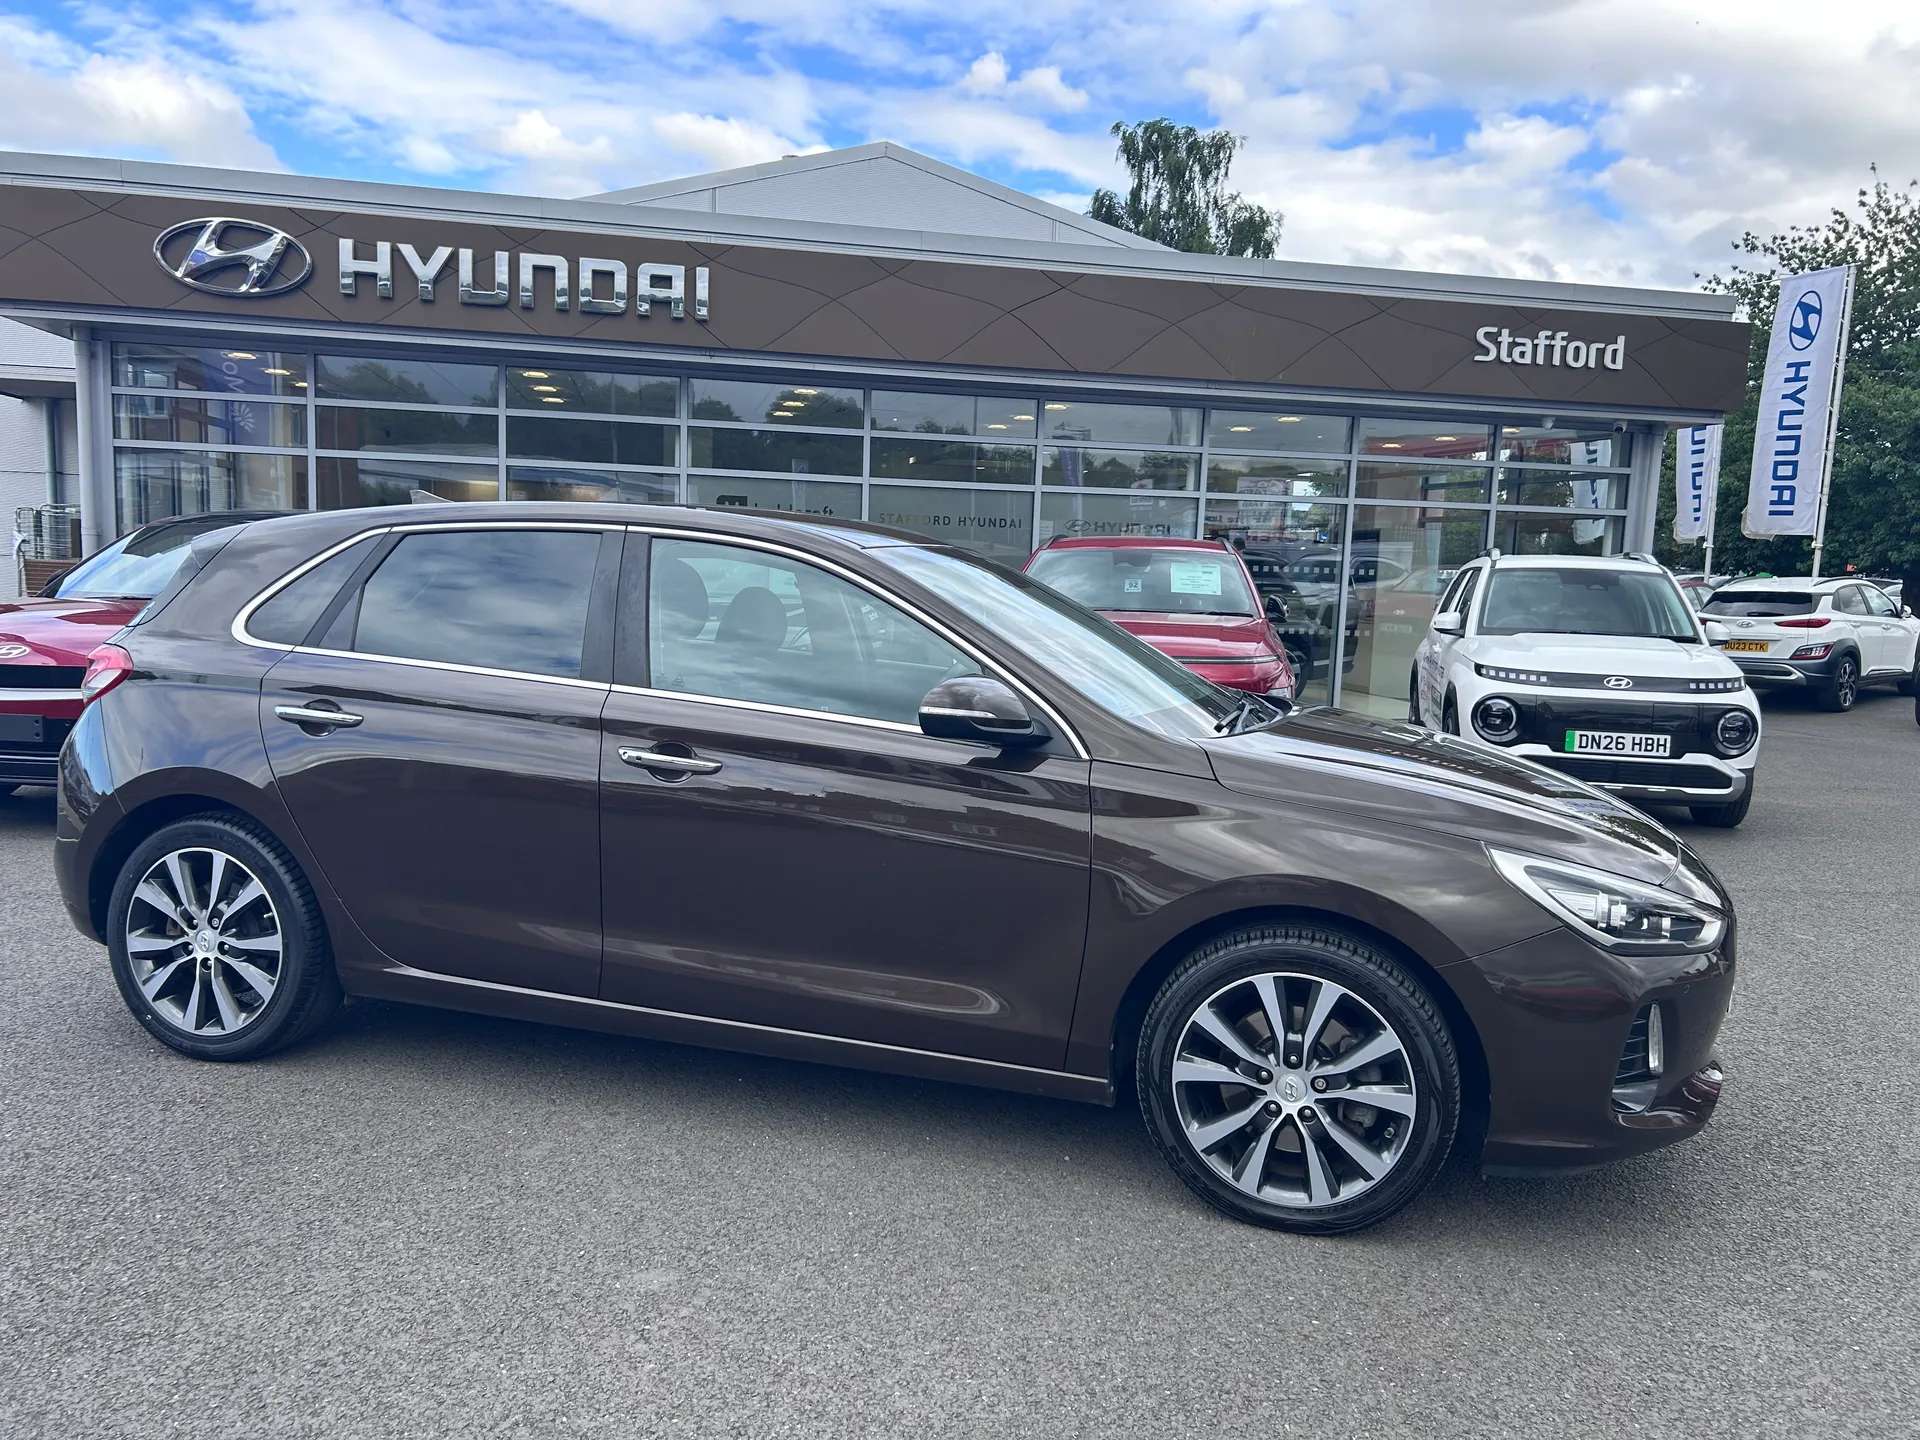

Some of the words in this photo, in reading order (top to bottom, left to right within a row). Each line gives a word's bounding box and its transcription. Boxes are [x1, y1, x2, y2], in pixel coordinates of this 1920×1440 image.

[338, 237, 710, 322] HYUNDAI
[1473, 326, 1626, 370] Stafford
[1767, 360, 1812, 516] HYUNDAI
[957, 514, 1023, 530] HYUNDAI
[1748, 641, 1766, 652] CTK
[1577, 733, 1626, 752] DN26
[1631, 735, 1668, 754] HBH
